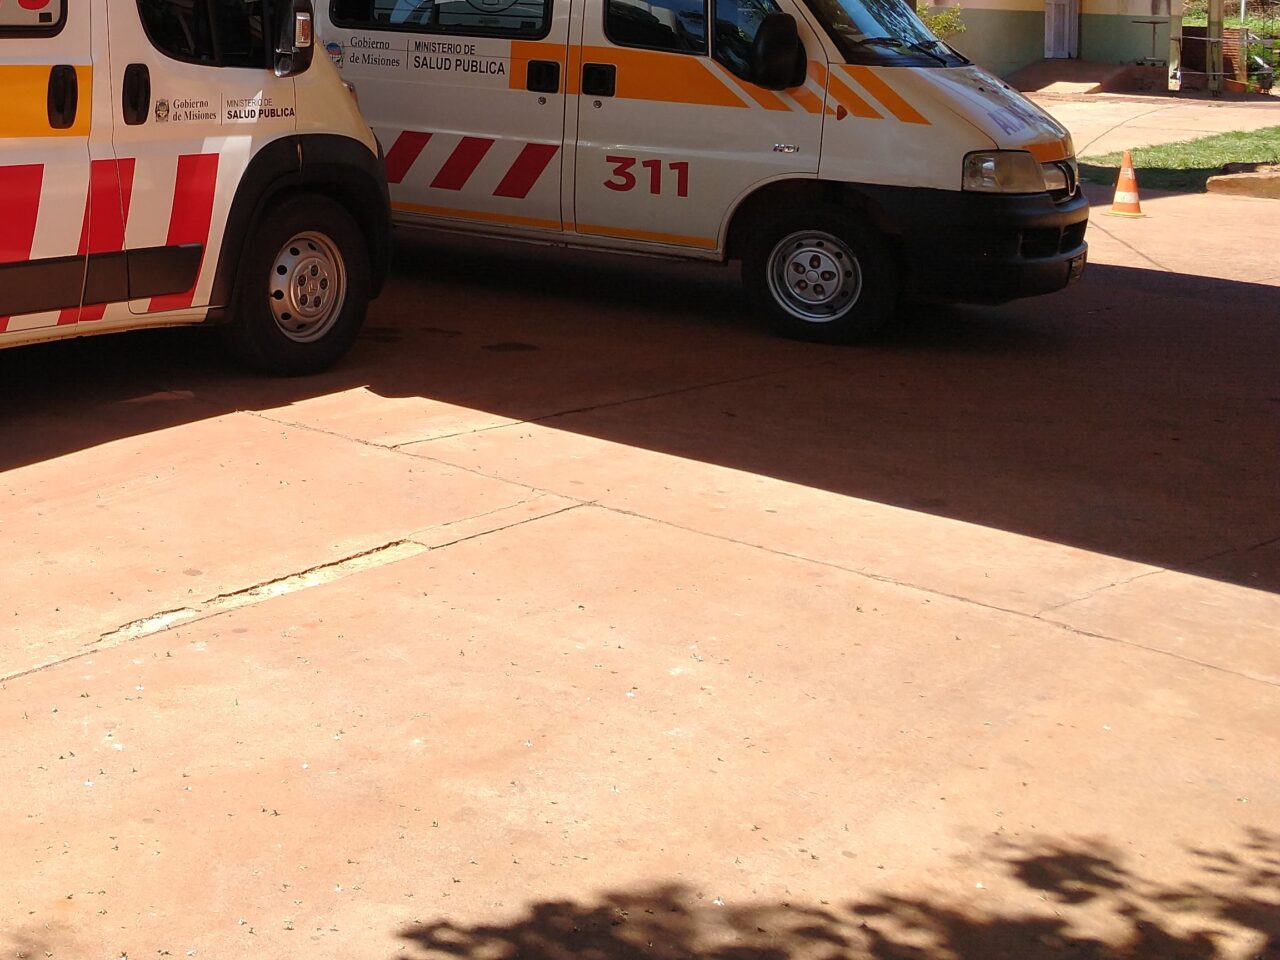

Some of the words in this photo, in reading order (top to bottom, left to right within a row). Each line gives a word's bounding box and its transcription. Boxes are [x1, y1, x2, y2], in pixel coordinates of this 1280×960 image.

[350, 36, 390, 50] Gobierno
[414, 41, 462, 55] MINISTERIO
[463, 44, 476, 55] DE
[349, 52, 360, 64] de
[361, 52, 401, 67] Misiones
[413, 55, 452, 71] SALUD
[454, 58, 506, 76] PUBLICA
[173, 98, 209, 109] Gobierno
[263, 97, 273, 107] DE
[172, 111, 182, 121] de
[183, 110, 217, 121] Misiones
[226, 109, 256, 120] SALUD
[258, 107, 295, 119] PUBLICA
[603, 155, 689, 198] 311
